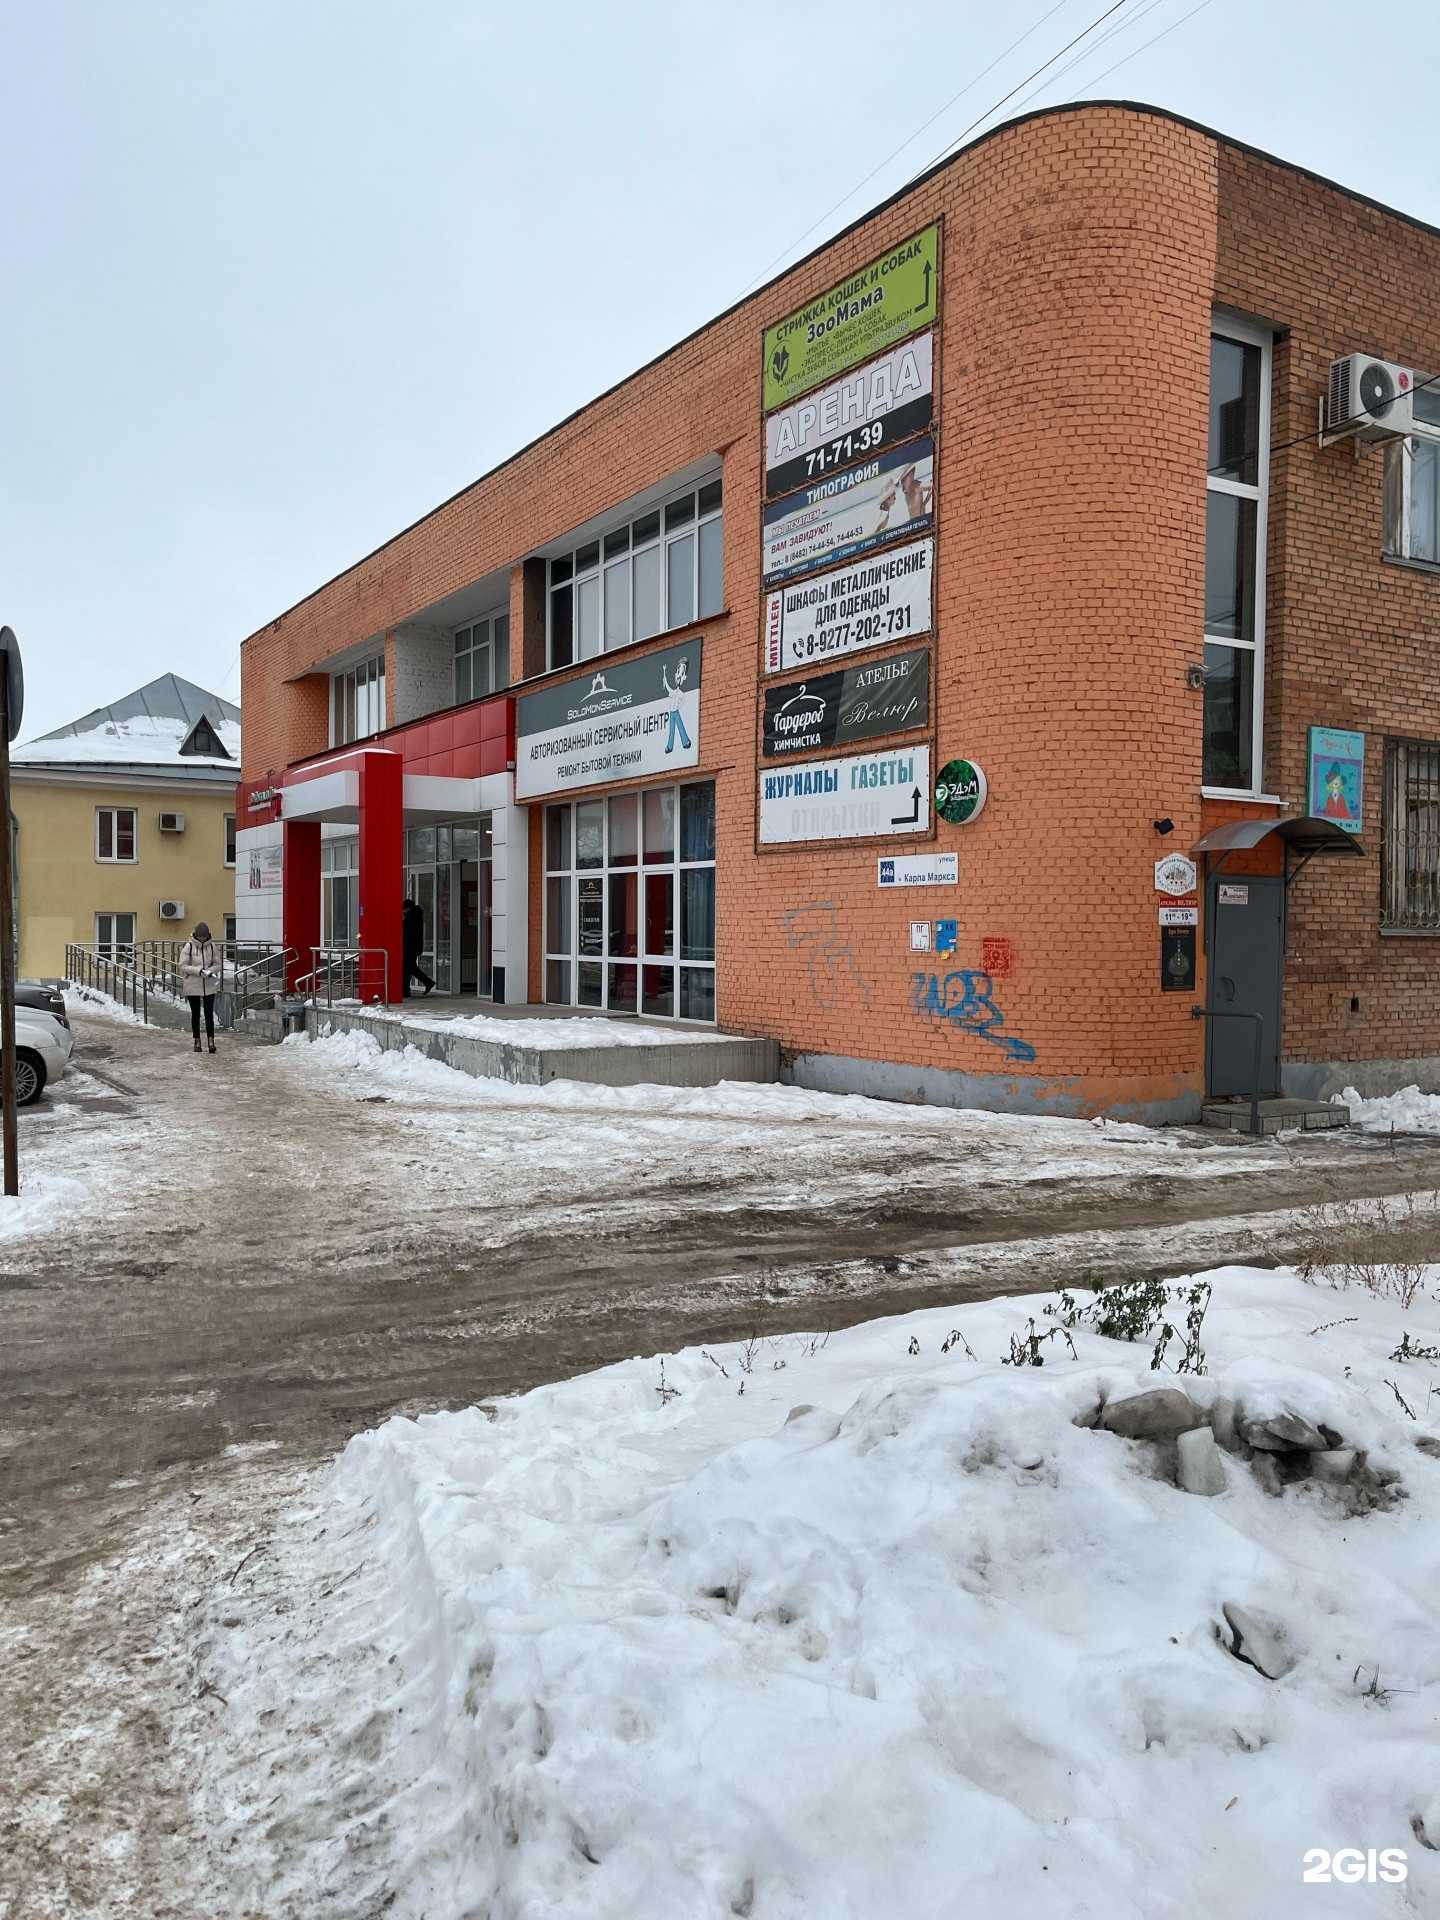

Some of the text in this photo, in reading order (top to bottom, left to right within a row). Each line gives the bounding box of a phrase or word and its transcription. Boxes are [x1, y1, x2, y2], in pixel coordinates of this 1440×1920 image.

[776, 304, 826, 341] СТРИЖКА
[828, 275, 868, 310] КОШЕК
[870, 268, 879, 283] И
[881, 240, 922, 276] СОБАК
[806, 286, 884, 343] ЗооМама
[775, 350, 922, 458] АРЕНДА
[805, 421, 884, 476] 71-71-39
[806, 461, 880, 505] ТИПОГРАФИЯ
[771, 540, 788, 554] ВАМ
[786, 550, 926, 613] ШКАФЫ МЕТАЛЛИЧЕСКИЕ
[815, 586, 890, 628] ДЛЯ ОДЕЖДЫ
[807, 605, 911, 656] 8-9277-202-731
[856, 660, 909, 688] АТЕЛЬЕ
[773, 704, 825, 735] Гардероб
[842, 696, 918, 726] Велюр
[530, 711, 670, 761] АВТОРИЗОВАННЫЙ СЕРВИСНЫЙ ЦЕНТР
[774, 733, 821, 751] ХИМЧИСТКА
[557, 749, 642, 778] РЕМОНТ БЫТОВОЙ ТЕХНИКИ
[765, 757, 914, 800] ЖУРНАЛЫ ГАЗЕТЫ
[904, 872, 955, 884] Карла Маркса
